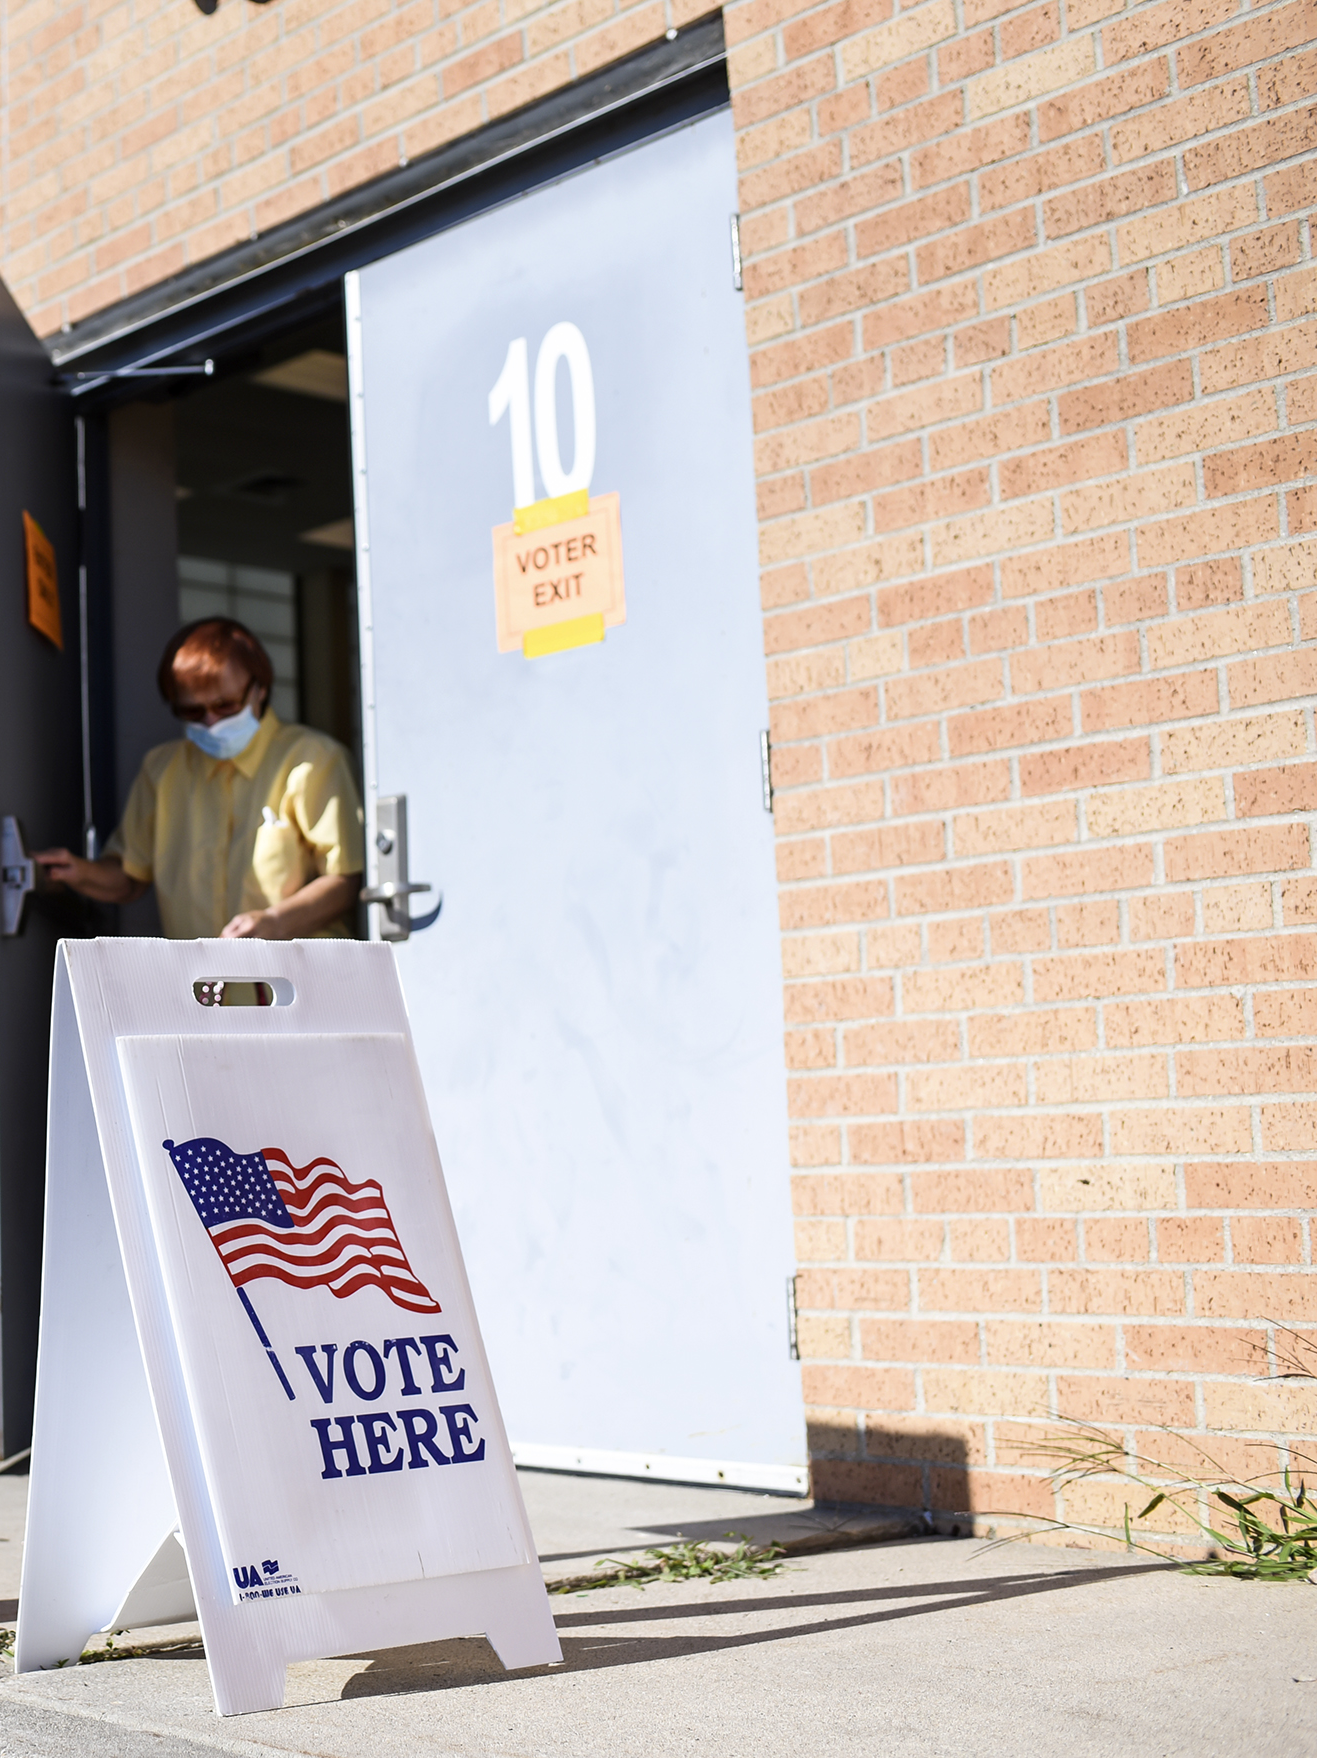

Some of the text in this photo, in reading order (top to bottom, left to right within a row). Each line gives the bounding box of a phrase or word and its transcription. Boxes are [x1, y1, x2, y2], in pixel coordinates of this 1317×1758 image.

[488, 320, 596, 510] 10
[516, 533, 598, 575] VOTER
[533, 572, 585, 609] EXIT
[294, 1334, 466, 1405] VOTE
[310, 1403, 486, 1480] HERE
[232, 1565, 264, 1589] UA
[275, 1587, 288, 1596] USE
[290, 1585, 301, 1594] UA
